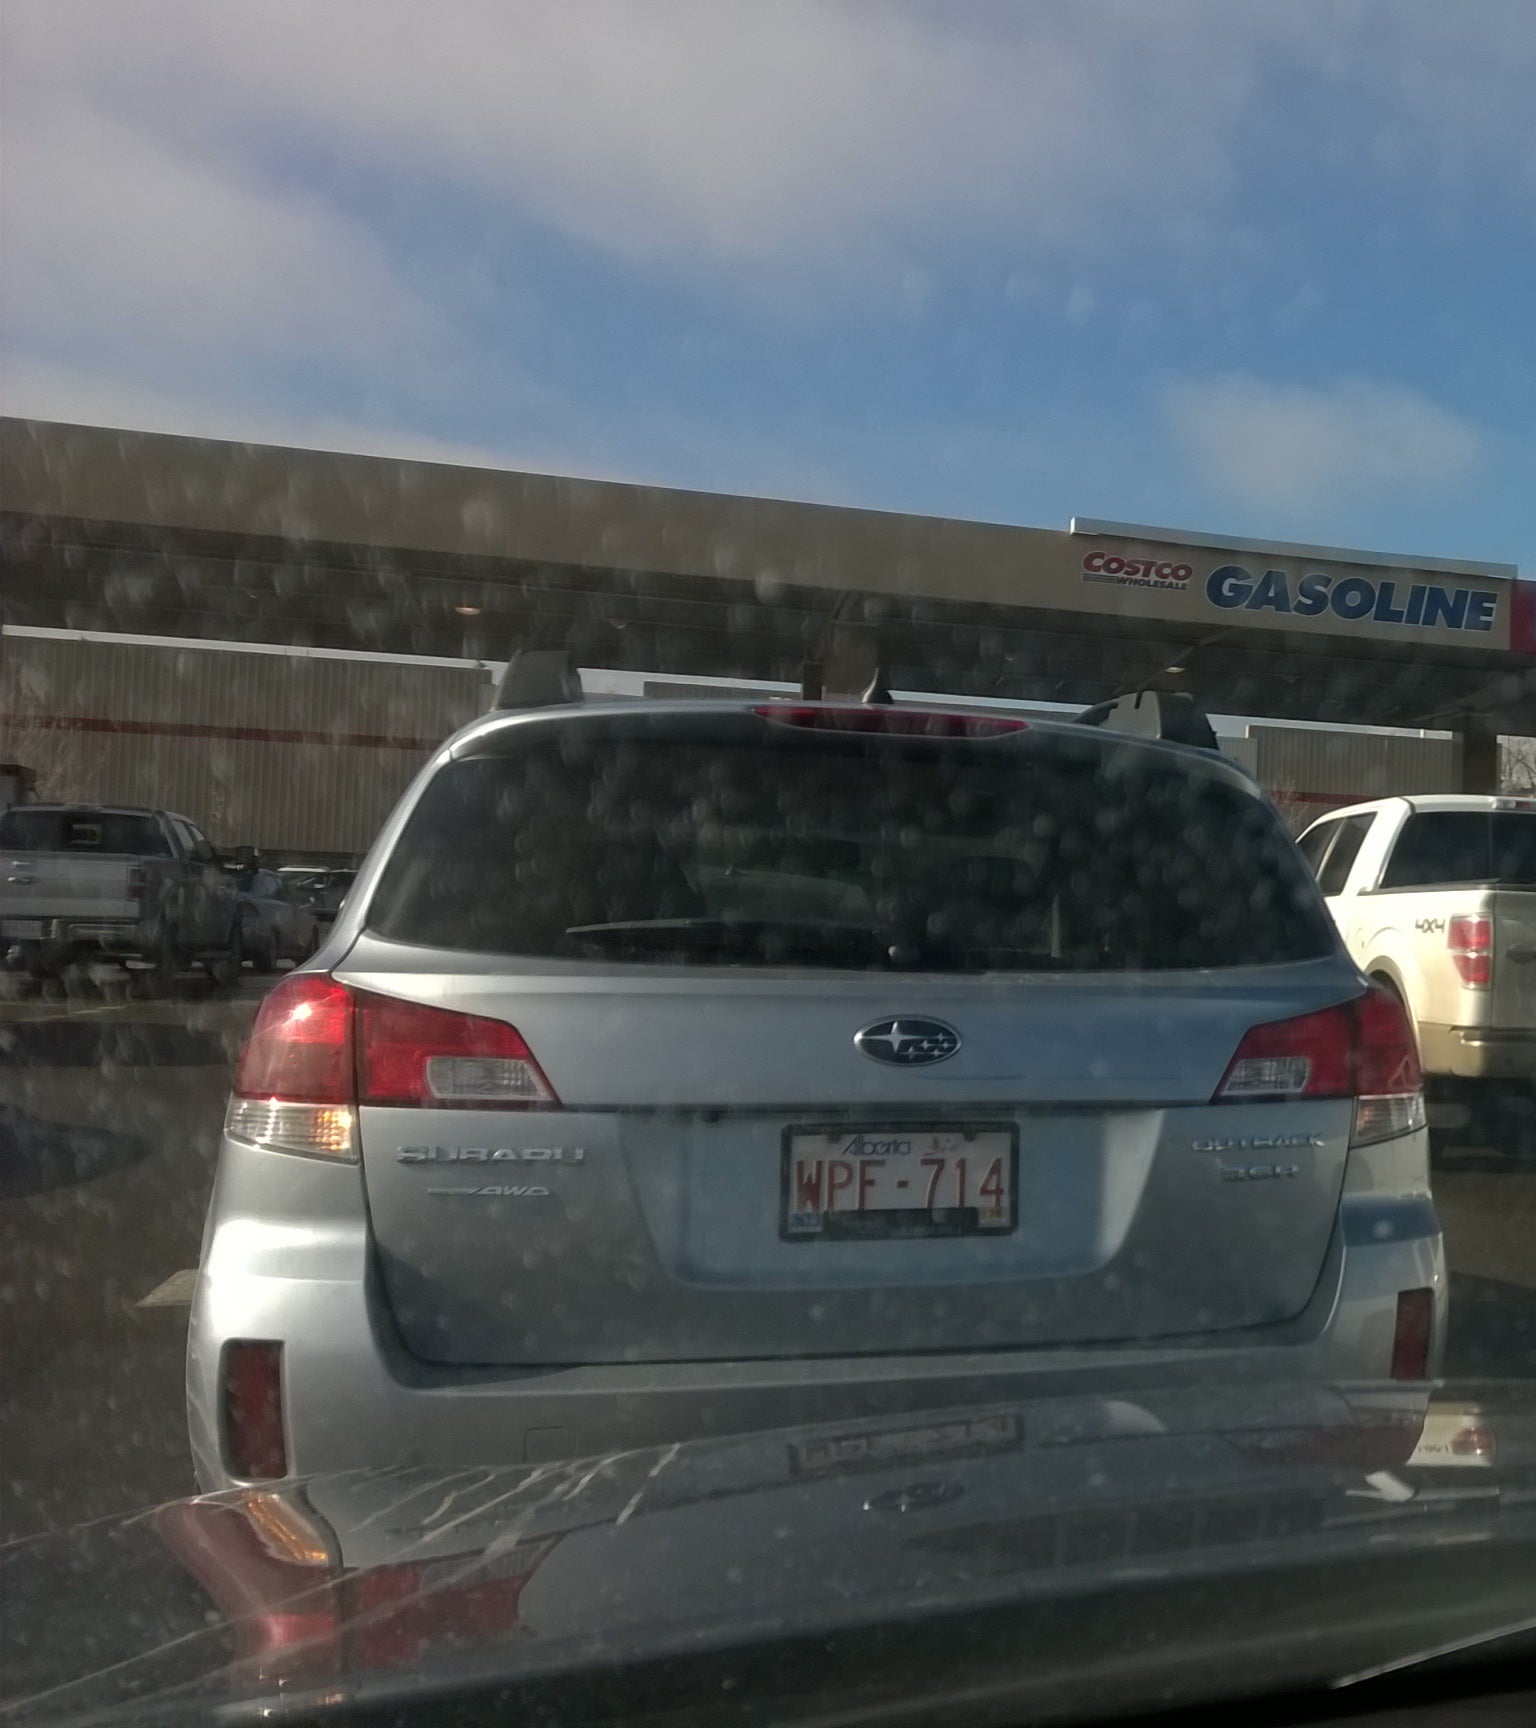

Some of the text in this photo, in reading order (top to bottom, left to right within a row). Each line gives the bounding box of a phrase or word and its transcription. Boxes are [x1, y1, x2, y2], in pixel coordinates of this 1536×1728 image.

[1082, 550, 1193, 581] COSTCO
[1115, 575, 1189, 591] WHOLESALE
[1205, 565, 1498, 632] GASOLINE
[842, 1135, 911, 1155] Alberta
[397, 1147, 585, 1162] SUBARU
[472, 1186, 551, 1196] AWD
